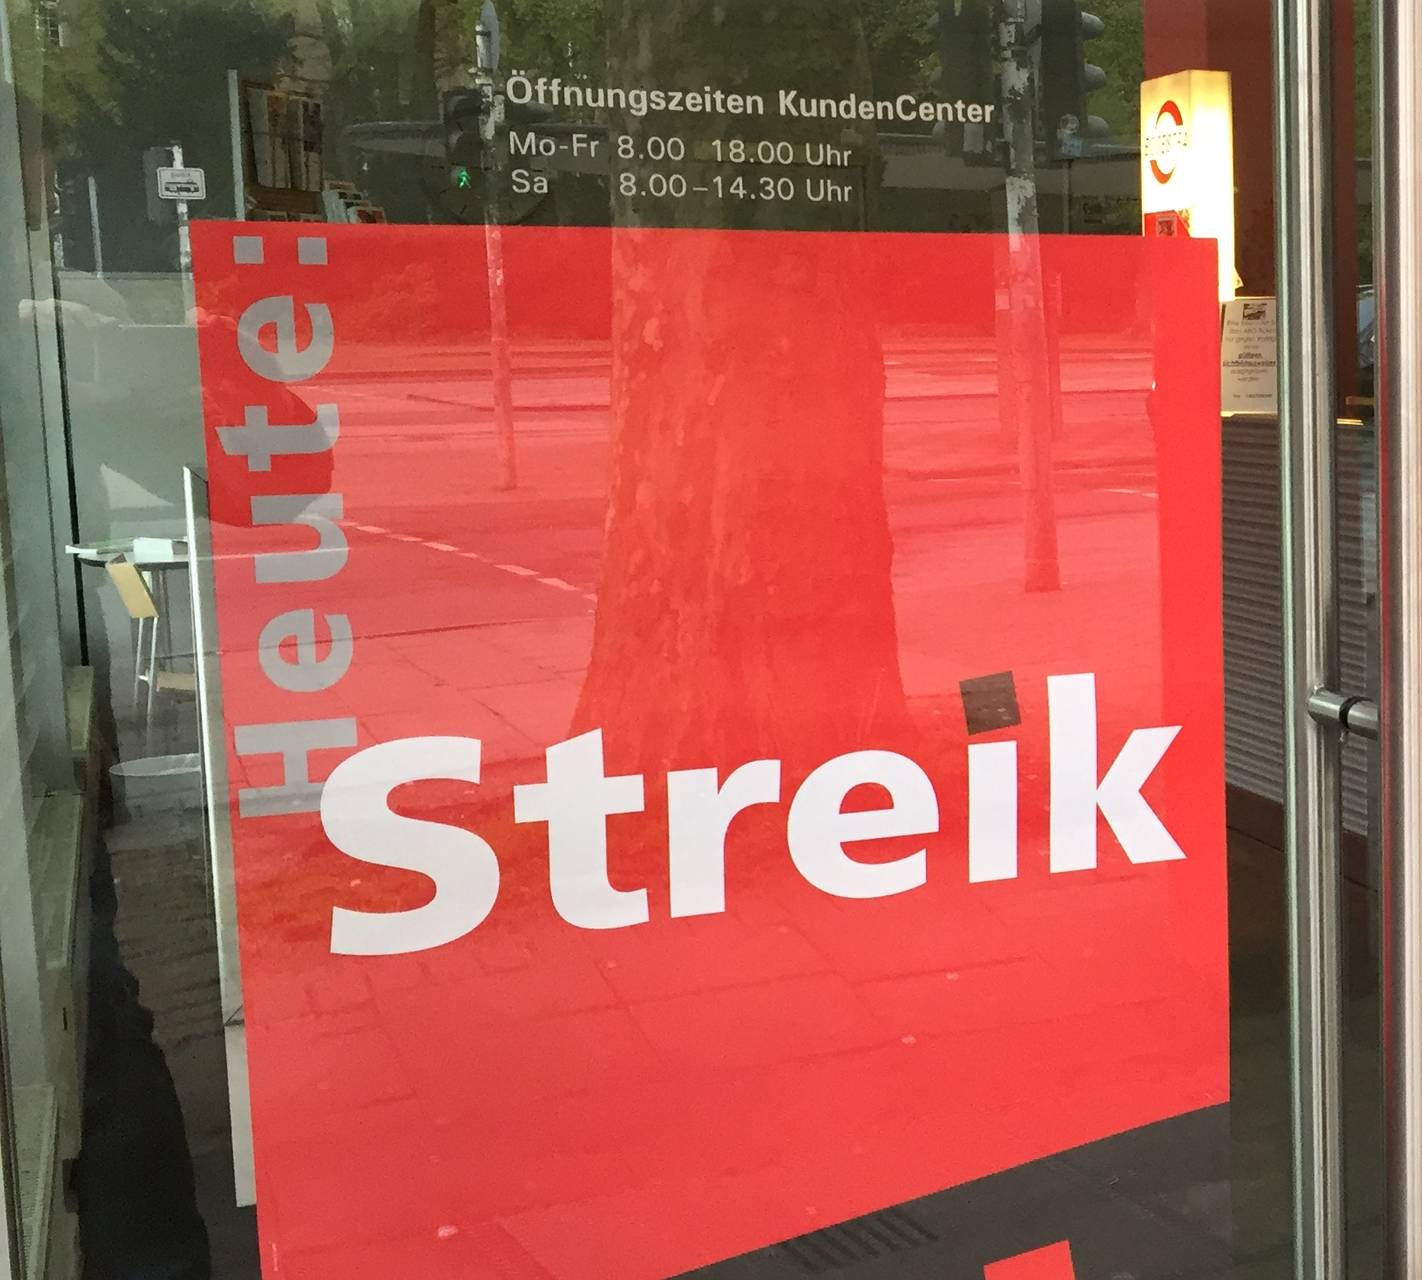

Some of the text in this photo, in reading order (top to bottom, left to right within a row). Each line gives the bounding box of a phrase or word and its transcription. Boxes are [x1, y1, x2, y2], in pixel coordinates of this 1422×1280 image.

[506, 70, 995, 124] Öffnungszeiten KundenCenter
[509, 131, 853, 167] Mo-Fr 8.00 18.00 Uhr
[511, 169, 549, 193] Sa
[806, 178, 853, 202] Uhr
[216, 235, 359, 819] Heute:
[320, 670, 1187, 956] Streik
